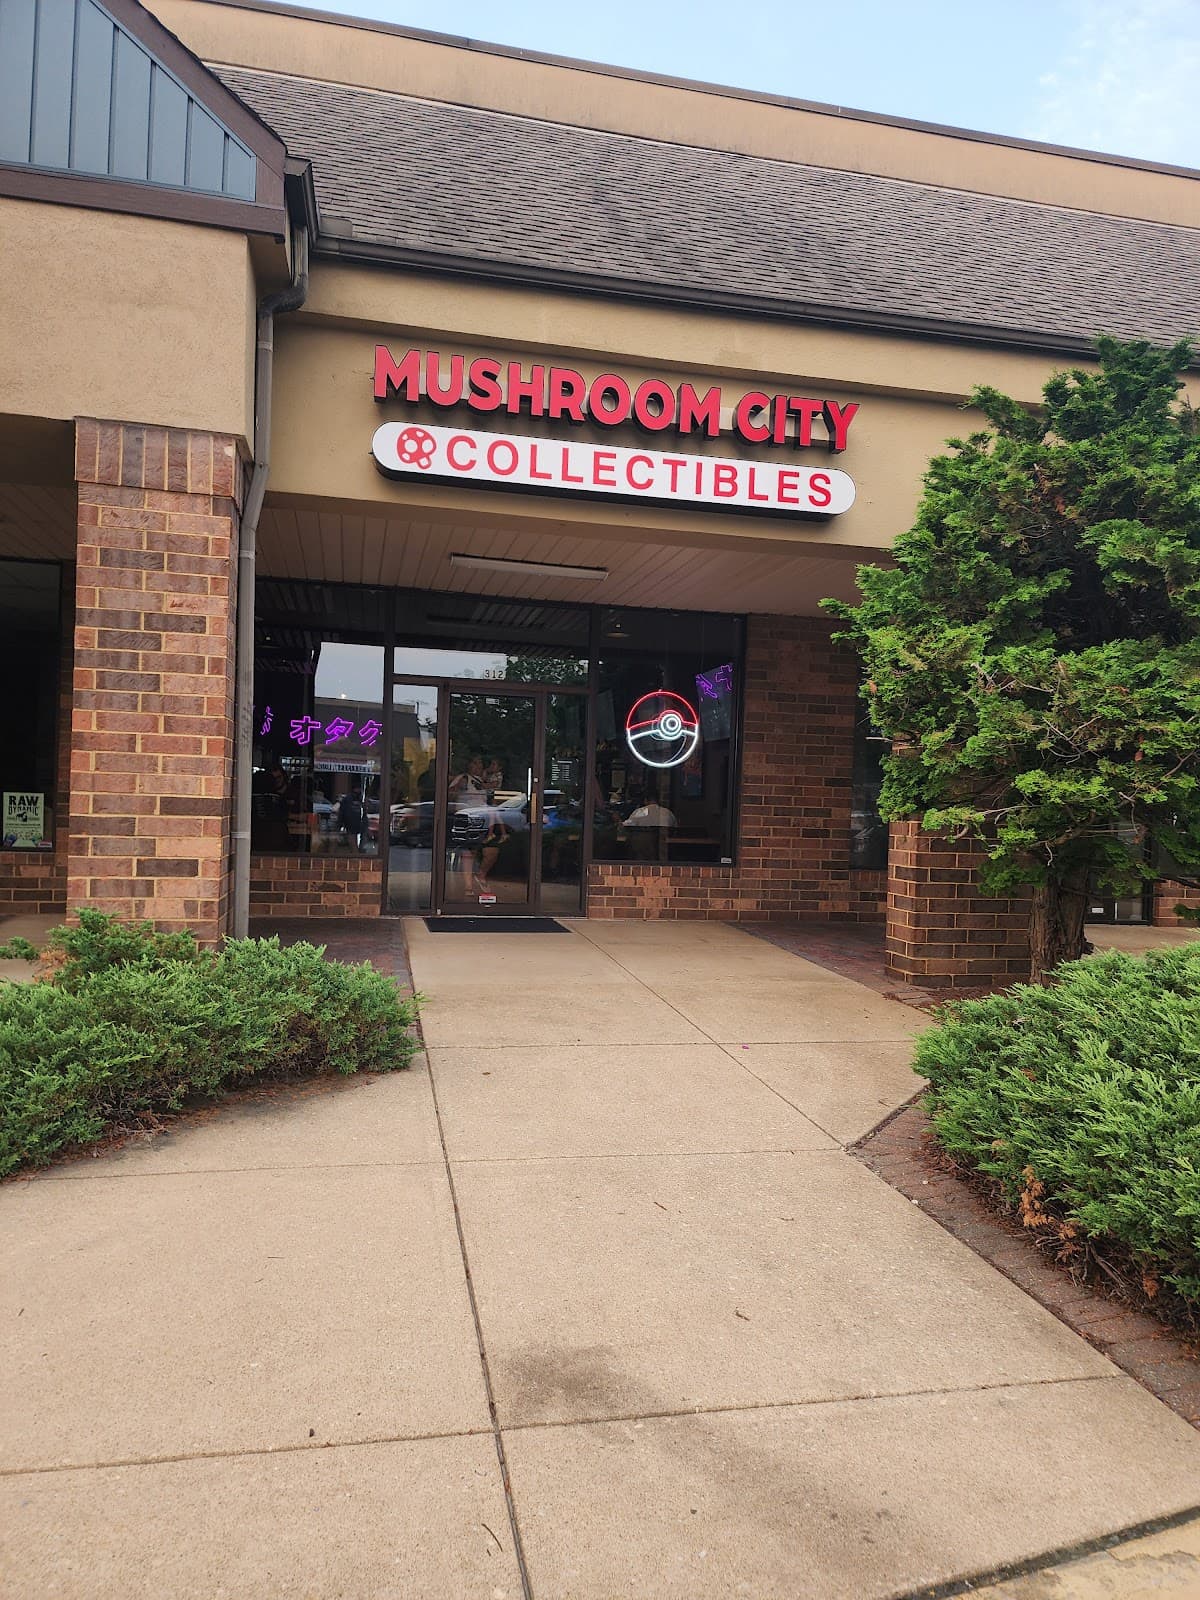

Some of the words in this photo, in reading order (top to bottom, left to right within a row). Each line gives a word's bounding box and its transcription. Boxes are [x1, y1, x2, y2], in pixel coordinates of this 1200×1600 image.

[373, 344, 722, 437] MUSHROOM
[737, 392, 861, 451] CITY
[446, 435, 833, 508] COLLECTIBLES
[484, 669, 504, 679] 312
[8, 795, 39, 806] RAW
